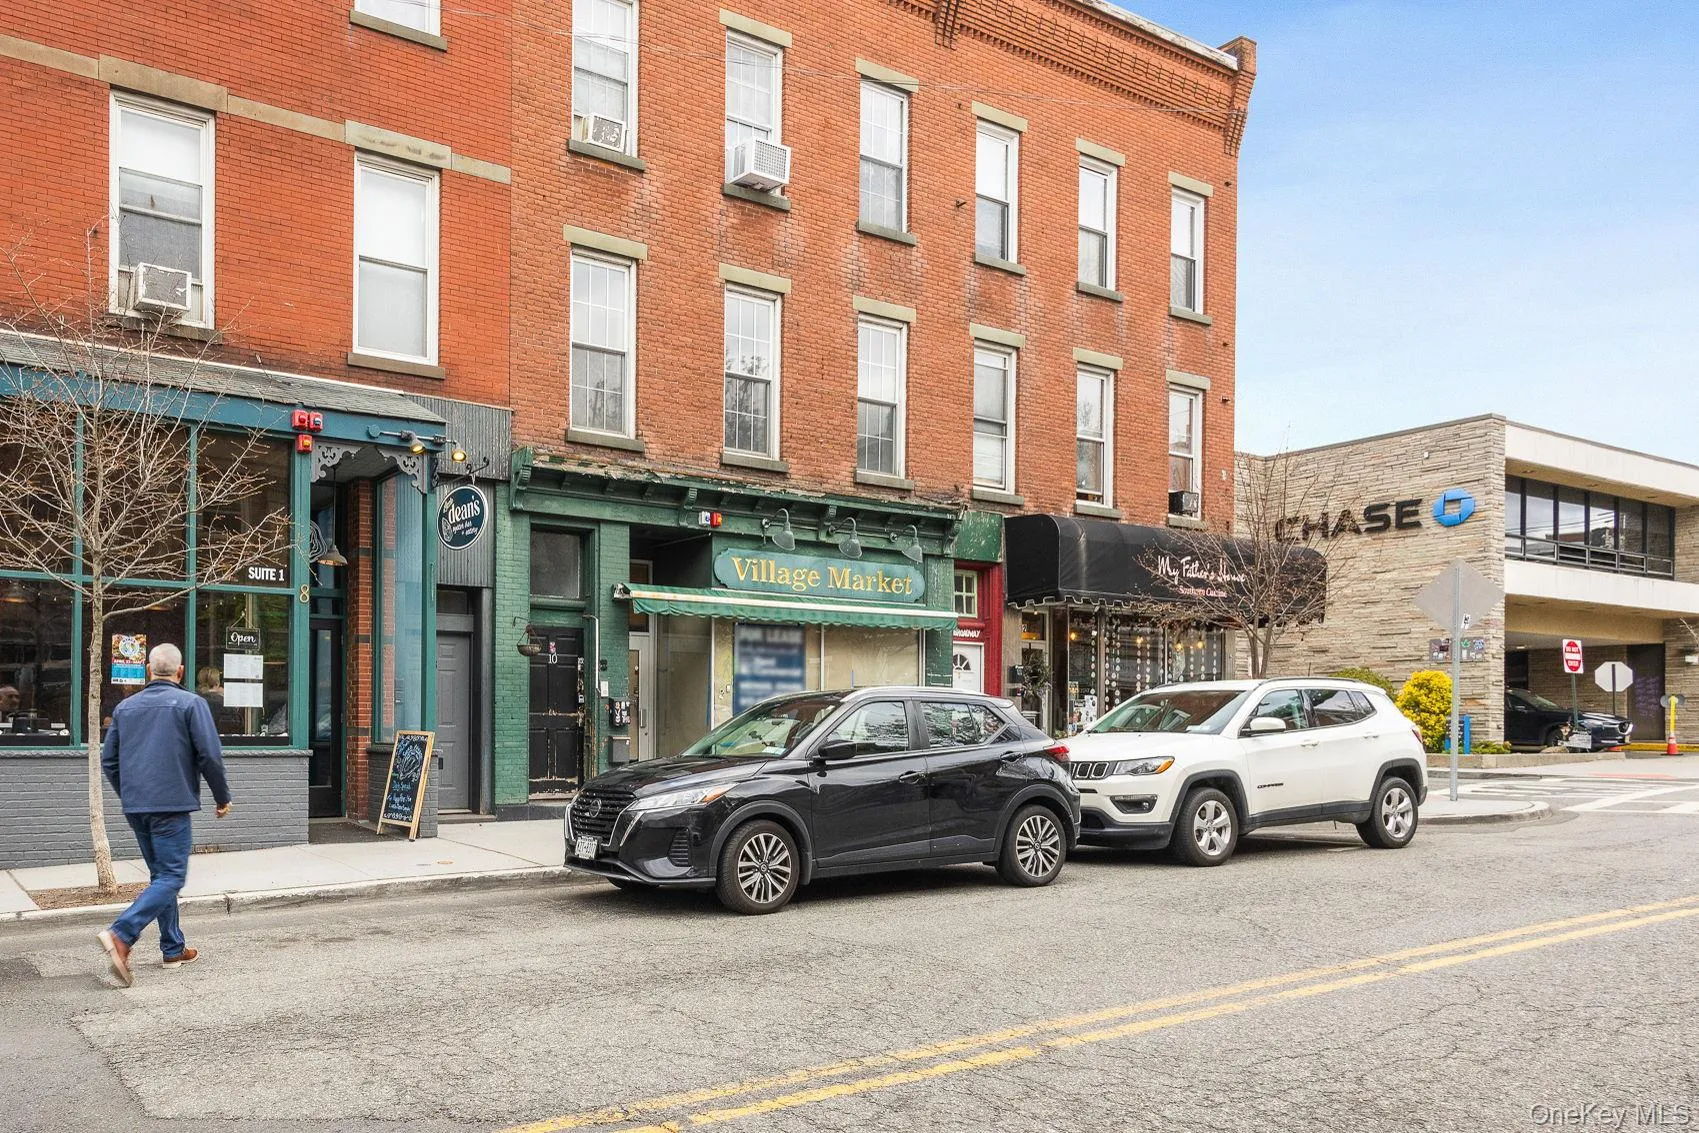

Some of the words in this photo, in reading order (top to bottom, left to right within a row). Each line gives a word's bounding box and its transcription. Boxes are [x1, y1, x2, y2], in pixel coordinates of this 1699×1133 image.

[449, 495, 480, 524] dean's
[1275, 499, 1422, 542] CHASE
[248, 567, 276, 581] SUITE
[279, 569, 285, 581] 1
[731, 556, 820, 592] Village
[827, 566, 912, 595] Market
[1157, 555, 1179, 585] My
[300, 584, 310, 603] 8
[230, 631, 257, 647] Open
[548, 652, 558, 664] 10
